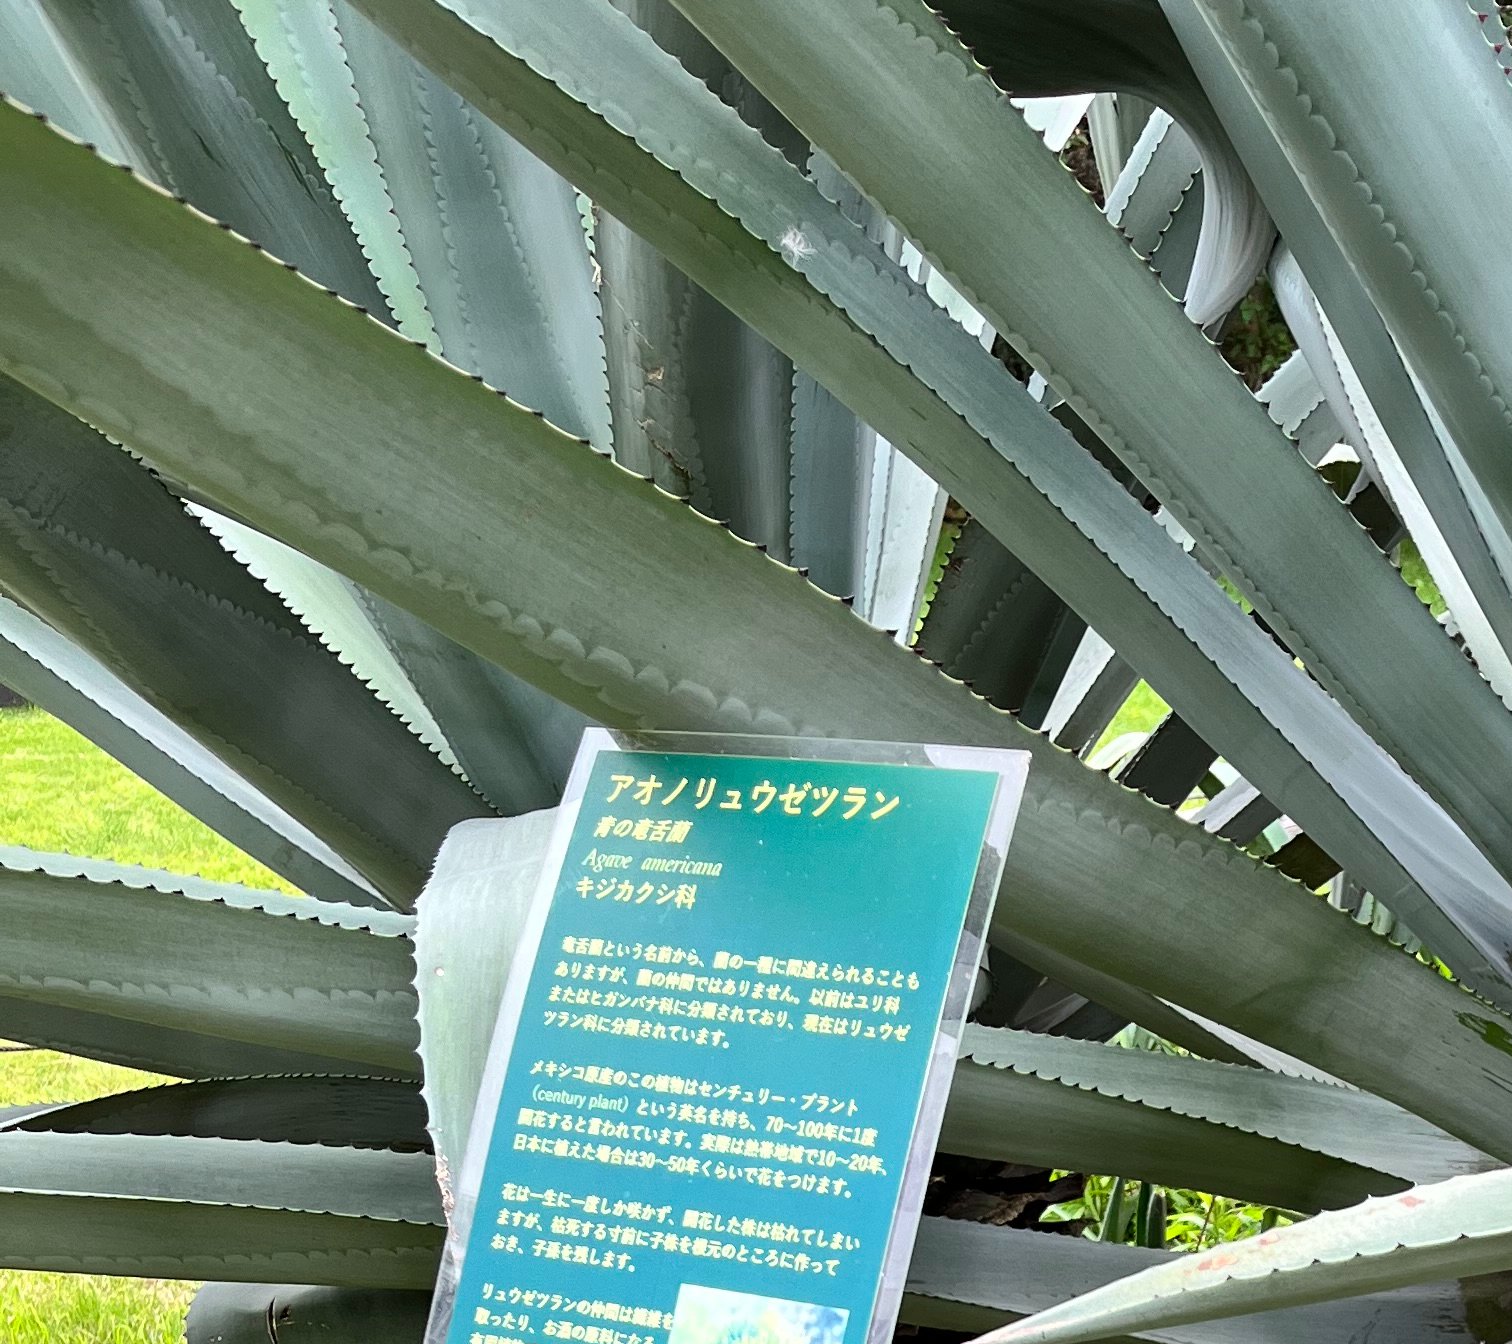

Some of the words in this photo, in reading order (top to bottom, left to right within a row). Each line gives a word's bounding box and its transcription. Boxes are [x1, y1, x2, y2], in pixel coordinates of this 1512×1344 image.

[605, 774, 900, 820] アオノリュウゼツラン
[581, 848, 633, 871] Agave
[641, 855, 723, 877] americana
[576, 876, 697, 909] キジカクシ科
[543, 1010, 731, 1049] ツラン科に分類されています。
[490, 1233, 636, 1273] おき、子孫を残します。
